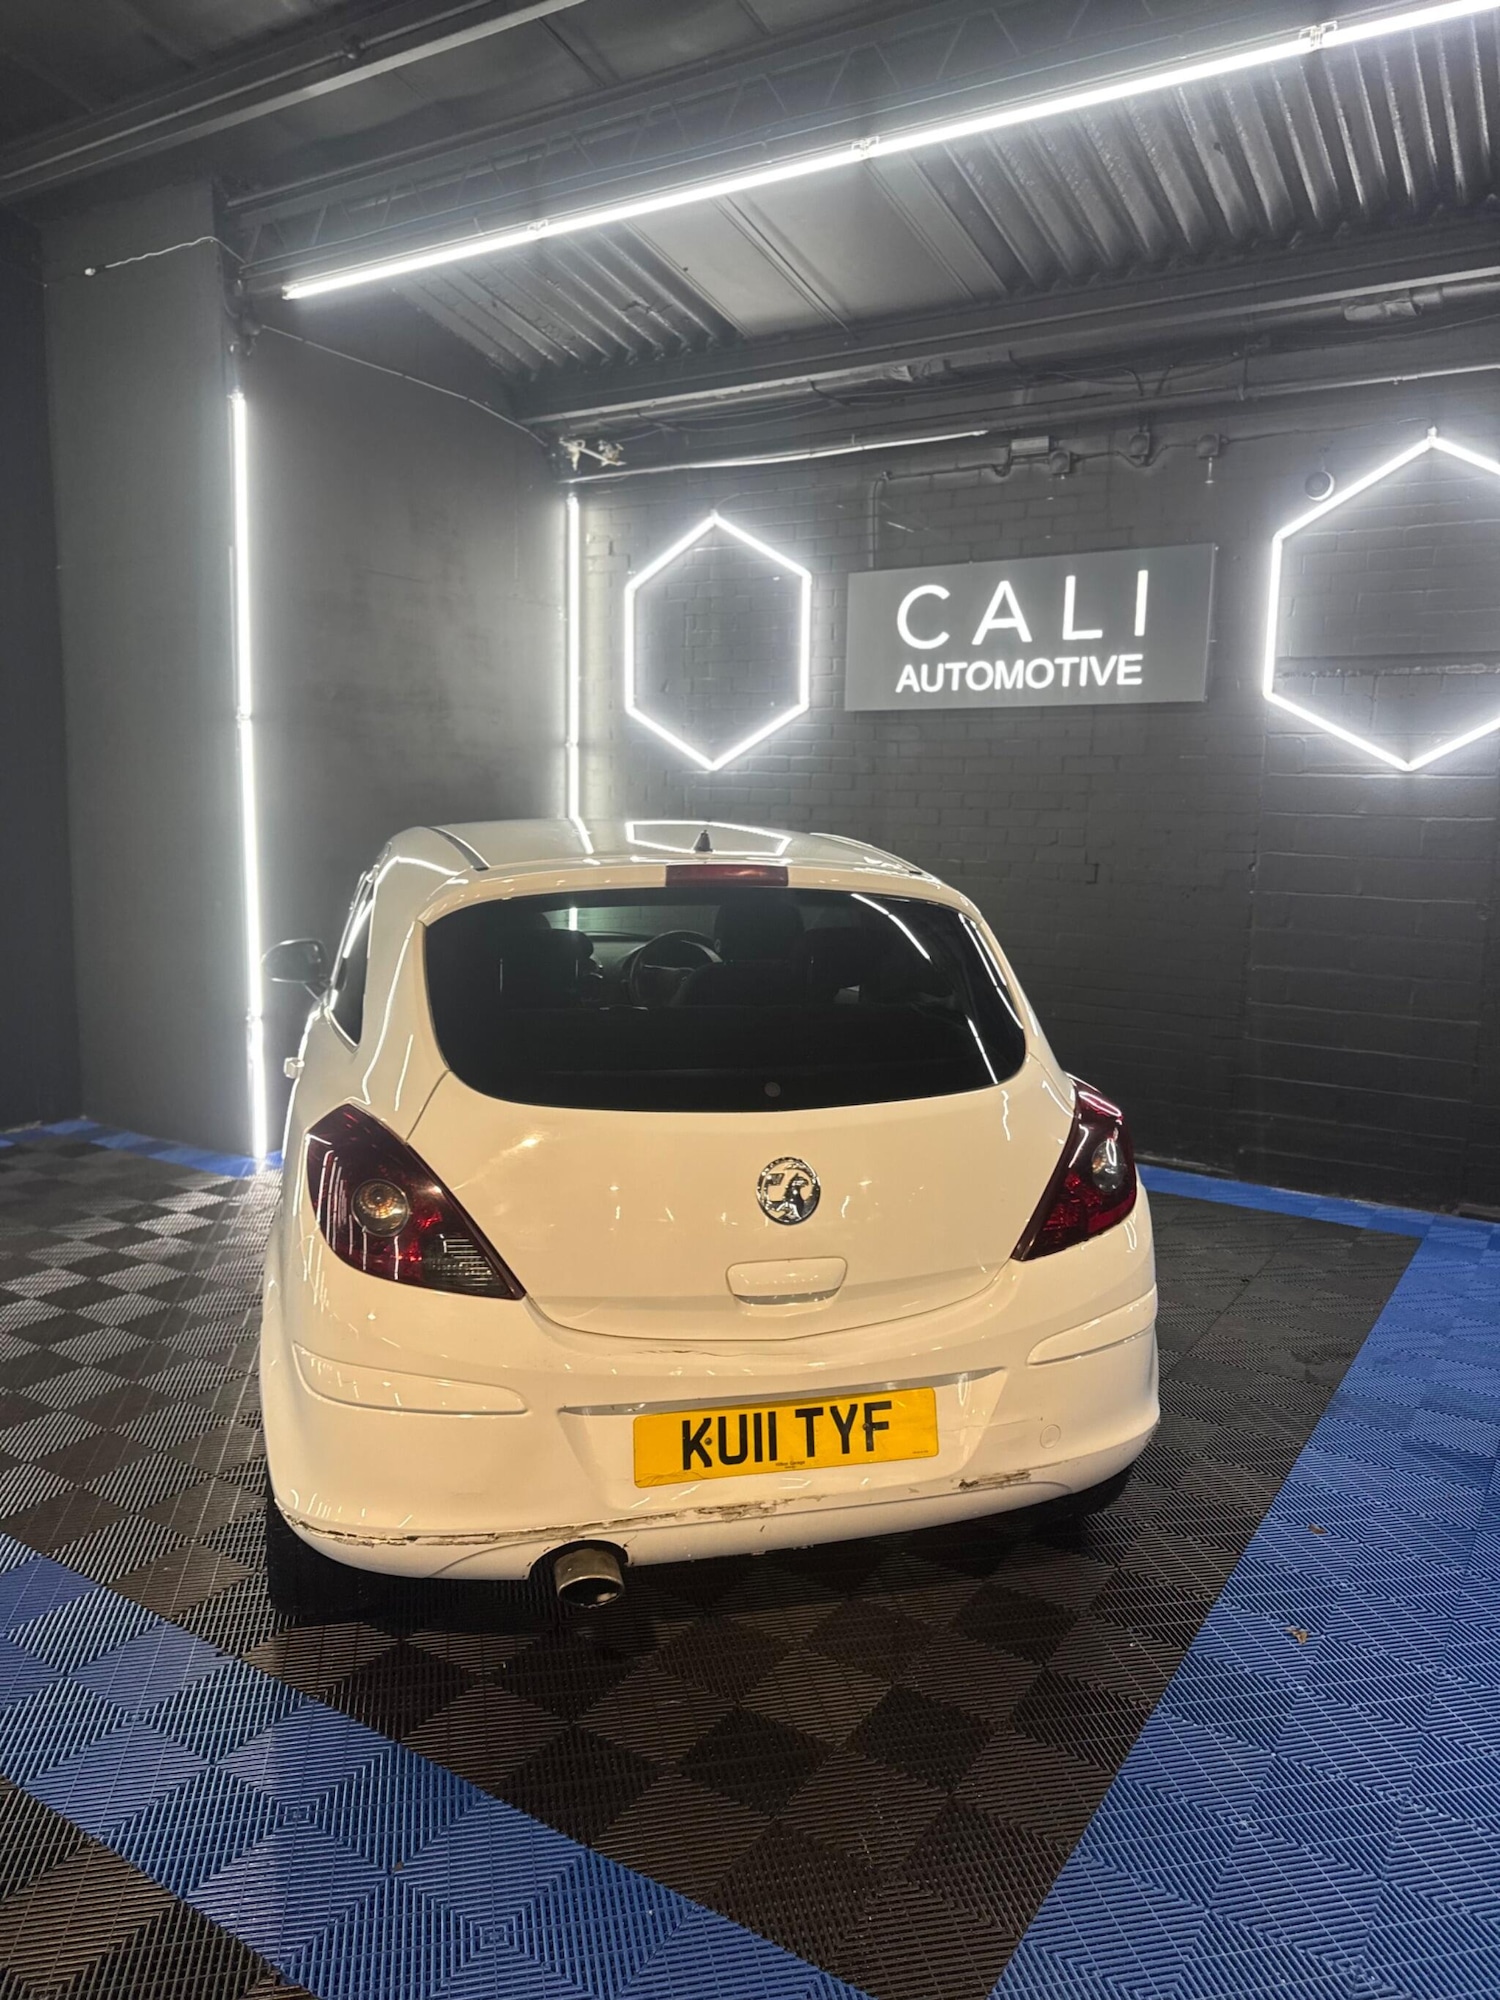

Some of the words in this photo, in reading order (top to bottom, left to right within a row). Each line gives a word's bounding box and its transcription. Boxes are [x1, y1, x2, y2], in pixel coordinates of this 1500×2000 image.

[897, 570, 1148, 649] CALI
[895, 654, 1143, 693] AUTOMOTIVE
[682, 1411, 777, 1470] KU11
[795, 1401, 892, 1457] TYF
